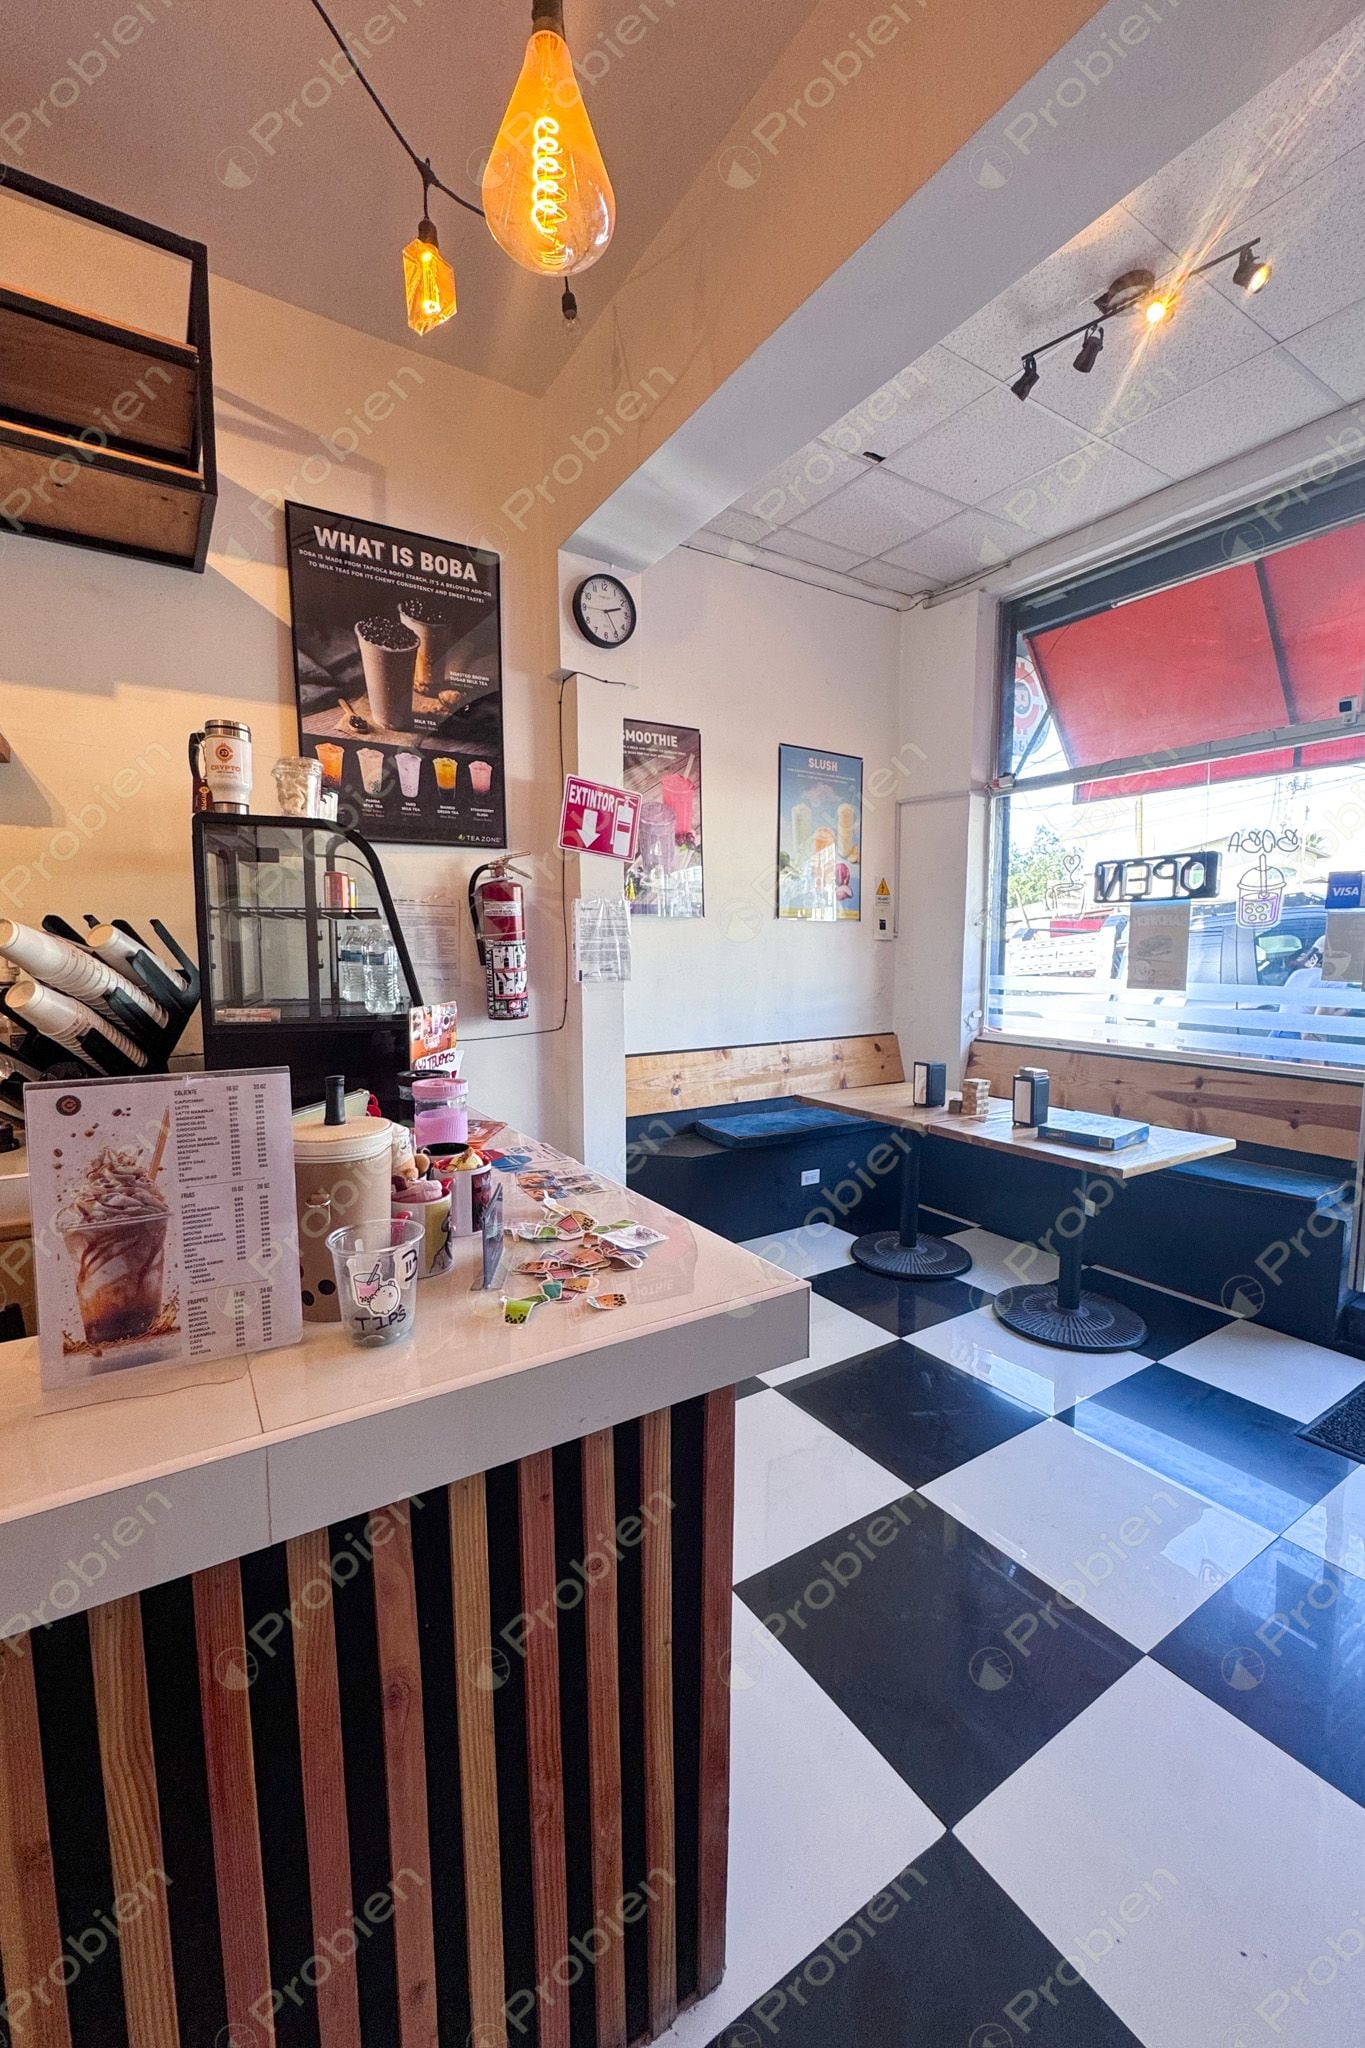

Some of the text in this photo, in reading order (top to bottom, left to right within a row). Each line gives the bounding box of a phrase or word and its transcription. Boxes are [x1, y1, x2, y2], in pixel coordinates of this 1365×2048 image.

[313, 526, 478, 582] WHAT IS BOBA
[299, 549, 316, 557] BOBA
[325, 556, 343, 564] MADE
[344, 560, 361, 568] FROM
[363, 564, 388, 574] TAPIOCA
[446, 583, 469, 592] BELOVED
[471, 589, 492, 597] ADD-ON
[319, 563, 334, 571] MILK
[335, 567, 350, 575] TEAS
[375, 576, 395, 584] CHEWY
[396, 580, 434, 593] CONSISTENCY
[449, 591, 466, 599] SWEET
[601, 584, 608, 592] 12
[808, 758, 838, 772] SLUSH
[568, 784, 615, 813] EXTINTOR
[1332, 887, 1359, 897] VISA
